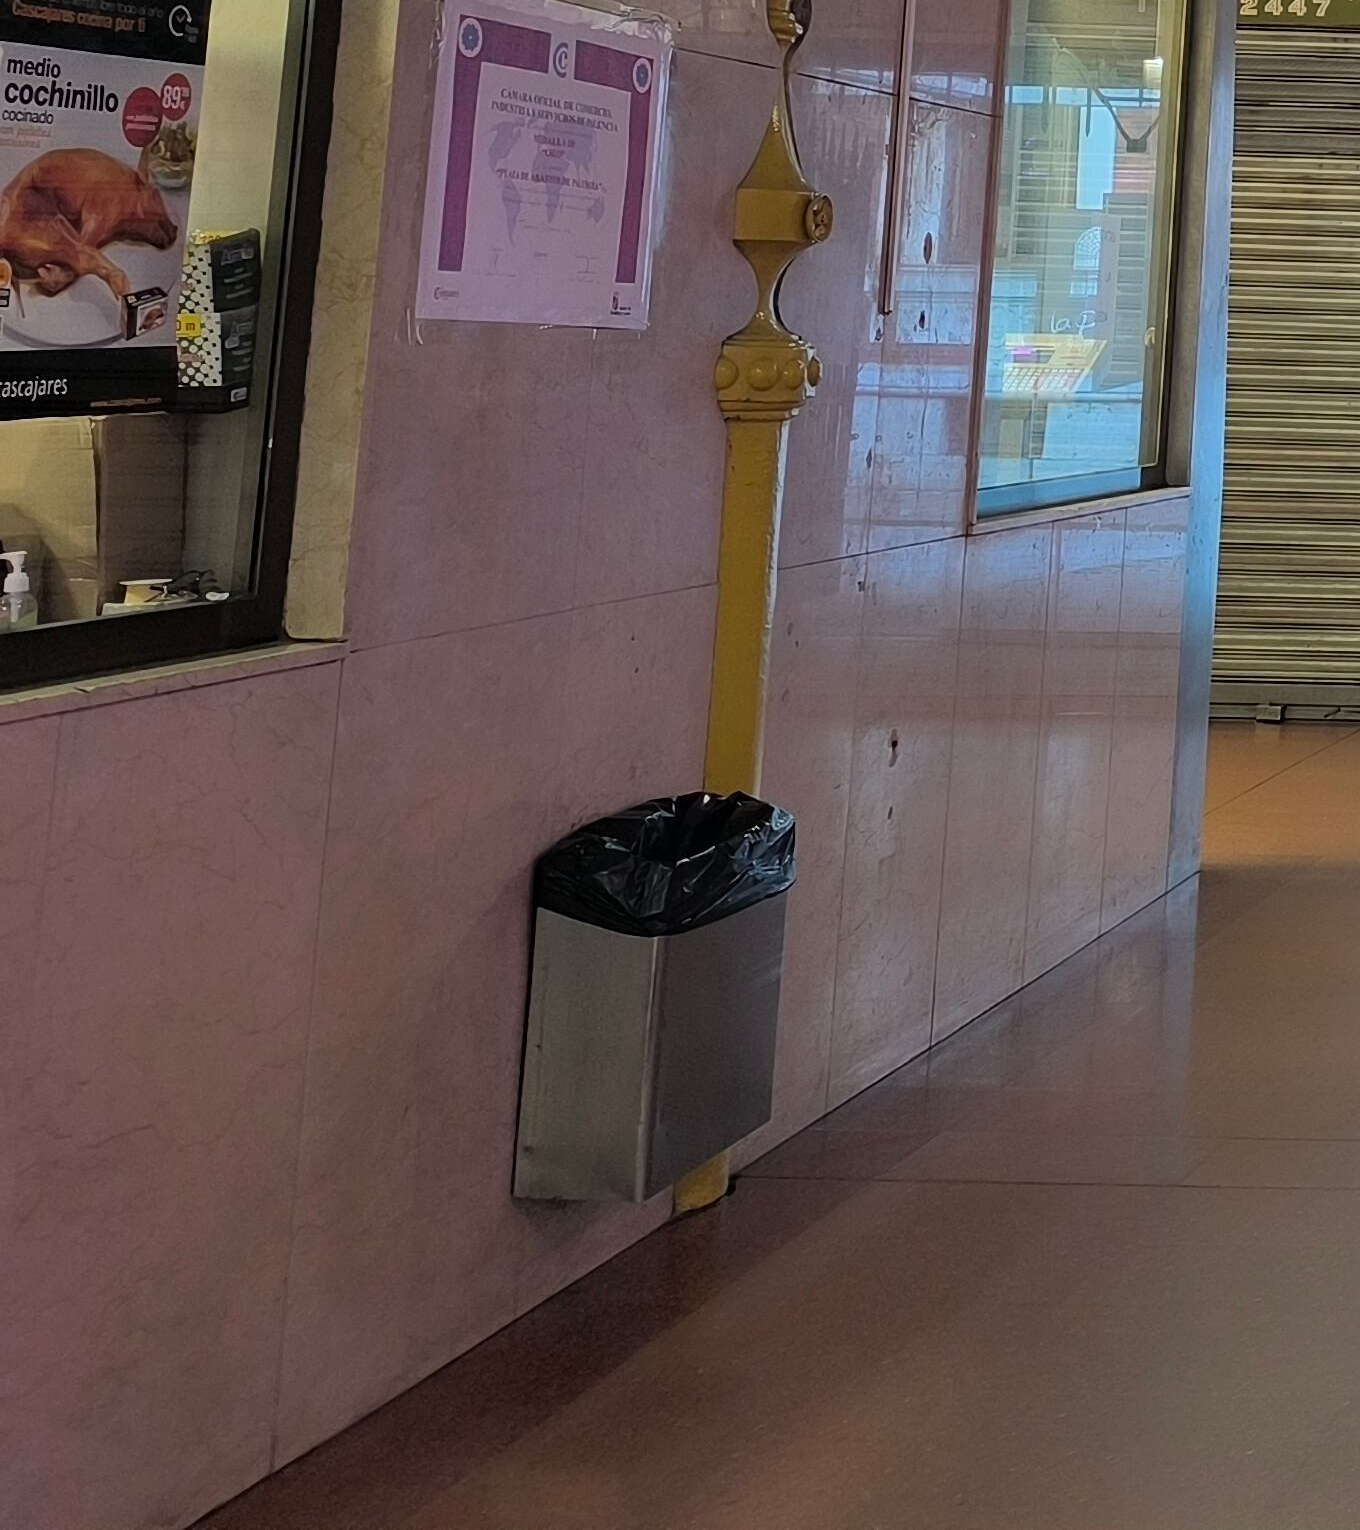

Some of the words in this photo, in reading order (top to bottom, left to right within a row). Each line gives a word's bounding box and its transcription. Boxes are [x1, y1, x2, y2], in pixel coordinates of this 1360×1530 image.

[7, 57, 61, 79] medio
[4, 79, 120, 113] cochinillo
[2, 107, 54, 126] cocinado
